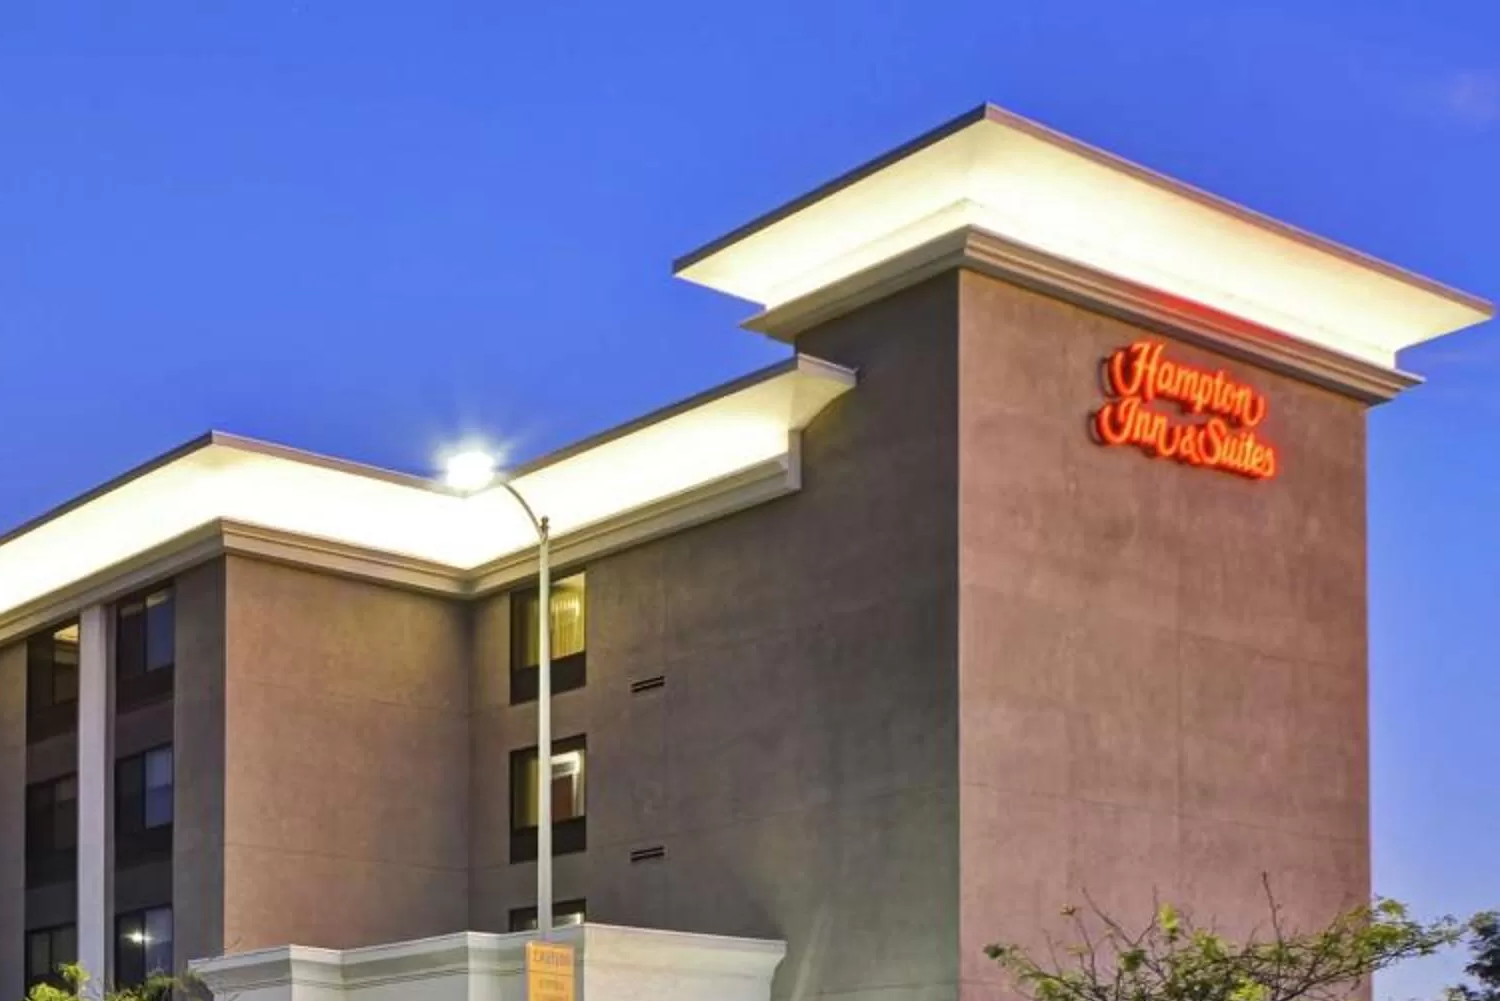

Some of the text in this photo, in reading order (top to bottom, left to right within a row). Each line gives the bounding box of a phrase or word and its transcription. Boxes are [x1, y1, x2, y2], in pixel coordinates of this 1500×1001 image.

[1108, 341, 1266, 427] Hampton
[1097, 398, 1276, 477] Inn & Suites
